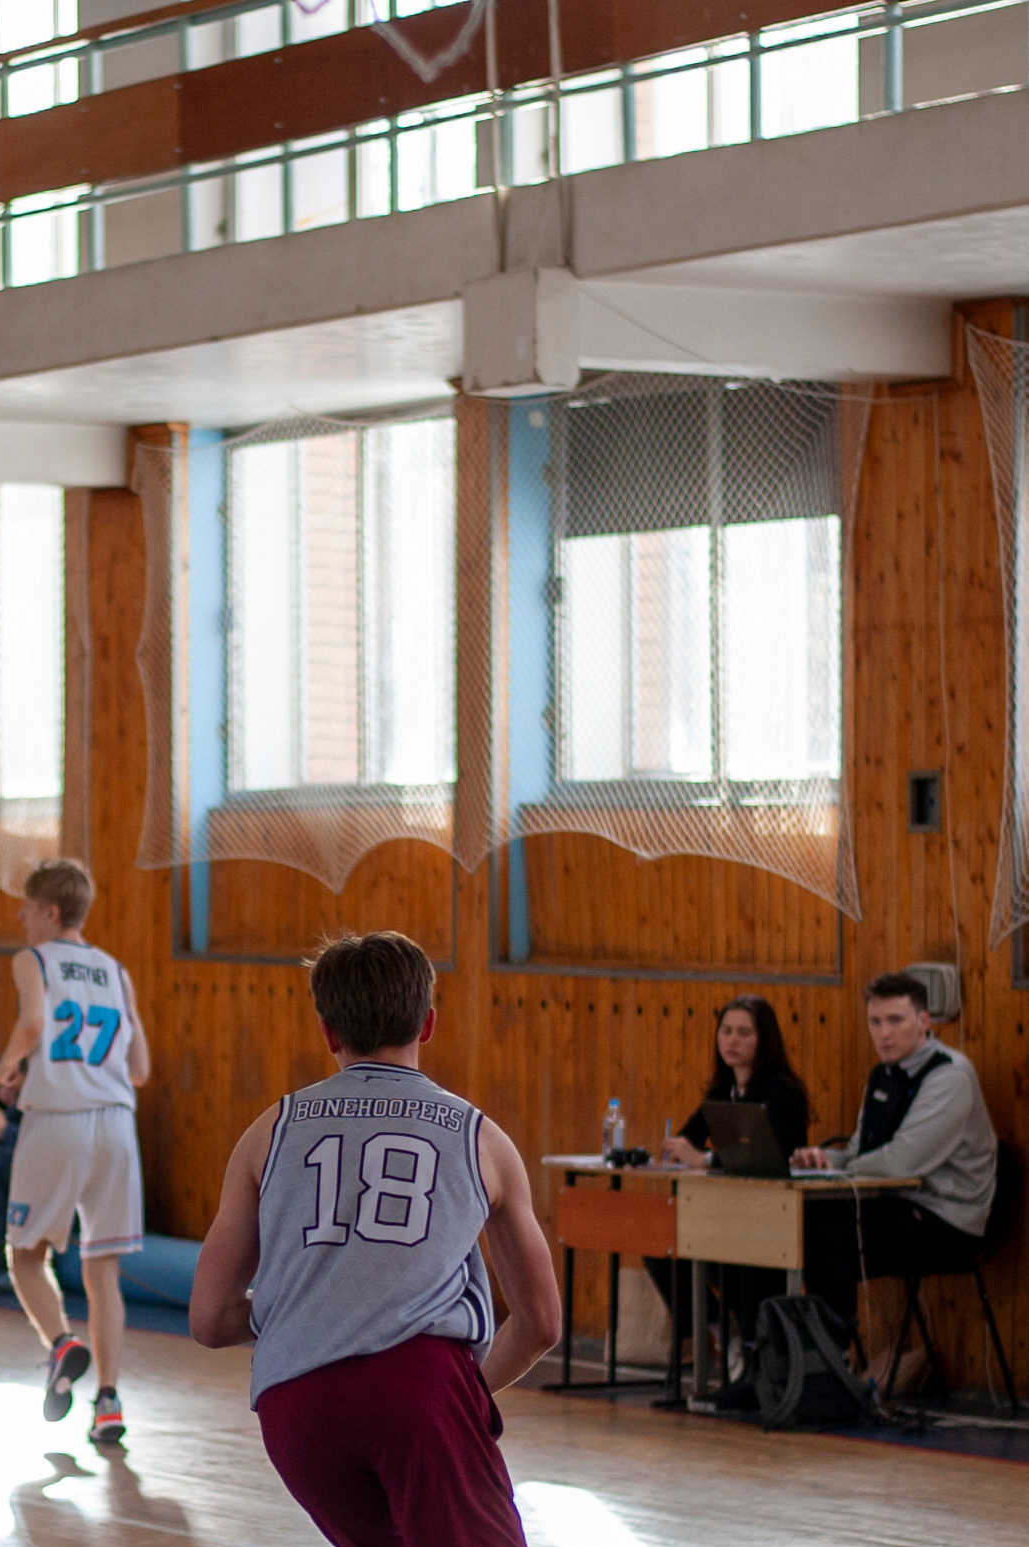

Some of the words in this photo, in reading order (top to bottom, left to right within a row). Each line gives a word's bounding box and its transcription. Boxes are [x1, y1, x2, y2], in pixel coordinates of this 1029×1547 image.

[50, 999, 121, 1067] 27
[293, 1098, 464, 1133] BONEHOOPERS
[303, 1132, 441, 1249] 18
